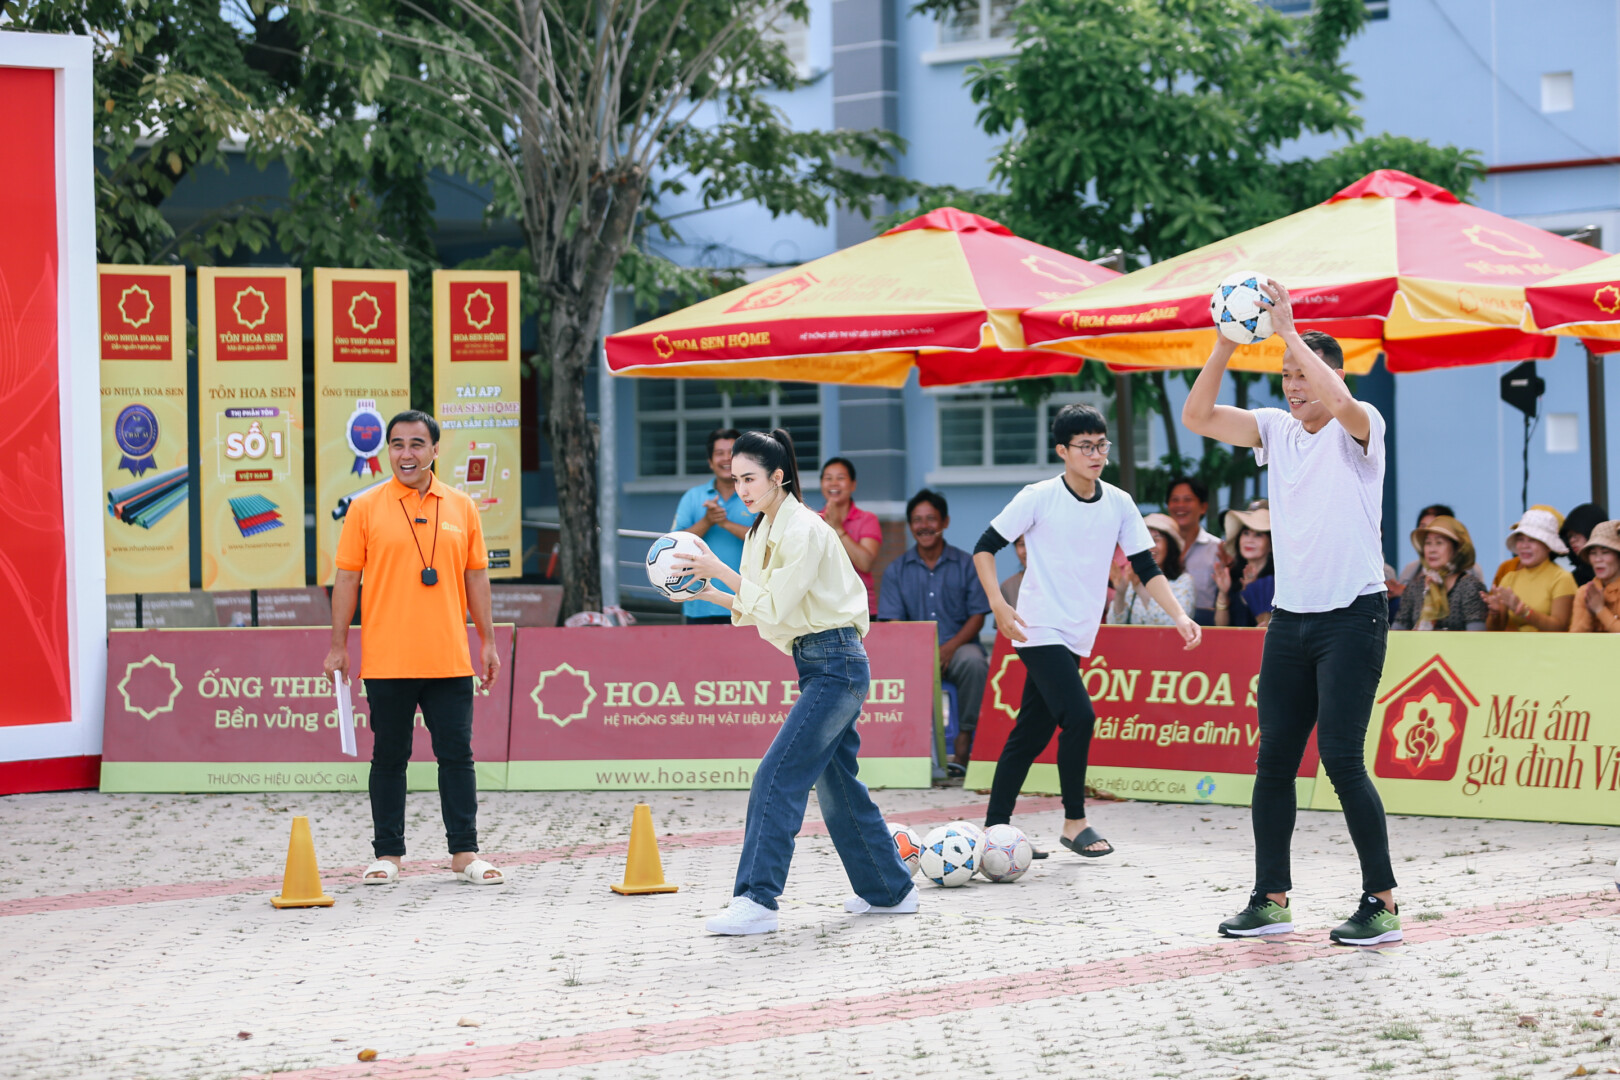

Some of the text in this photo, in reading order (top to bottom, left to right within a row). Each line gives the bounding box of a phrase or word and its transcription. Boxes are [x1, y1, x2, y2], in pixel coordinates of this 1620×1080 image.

[219, 331, 284, 343] TÔN HOA SEN
[671, 331, 771, 351] HOA SEN HOME
[100, 387, 112, 396] NG
[143, 387, 163, 396] HOA
[165, 387, 184, 396] SEN
[209, 384, 296, 399] TÔN HOA SEN
[370, 388, 389, 397] HOA
[391, 388, 408, 397] SEN
[478, 386, 502, 397] APP
[442, 401, 520, 414] HOA SEN HOME
[442, 420, 464, 430] MUA
[226, 421, 282, 458] SỐ 1
[198, 668, 264, 698] ỐNG
[270, 672, 352, 698] THÉ
[1078, 656, 1142, 702] ÔN
[1145, 670, 1235, 706] HOA
[603, 679, 905, 707] HOA SEN HE
[215, 706, 368, 732] Bền vững đn
[603, 713, 620, 727] HỆ
[622, 712, 667, 725] THỐNG
[670, 712, 694, 725] SIÊU
[697, 712, 715, 726] THỊ
[718, 711, 740, 727] VẬT
[743, 711, 766, 726] LIỆU
[857, 711, 871, 724] ỘI
[874, 709, 904, 722] THẤT
[1483, 694, 1591, 741] Mái ấm
[1120, 714, 1156, 741] ấm
[1156, 720, 1191, 747] gia
[1193, 720, 1241, 746] đình
[207, 770, 358, 786] THƯƠNG HIỆU QUỐC GIA
[596, 767, 756, 784] www.hoasenh
[1462, 743, 1620, 796] gia đình Vi
[1105, 777, 1129, 792] HIỆU
[1131, 778, 1165, 793] QUỐC
[1167, 781, 1187, 794] GIA
